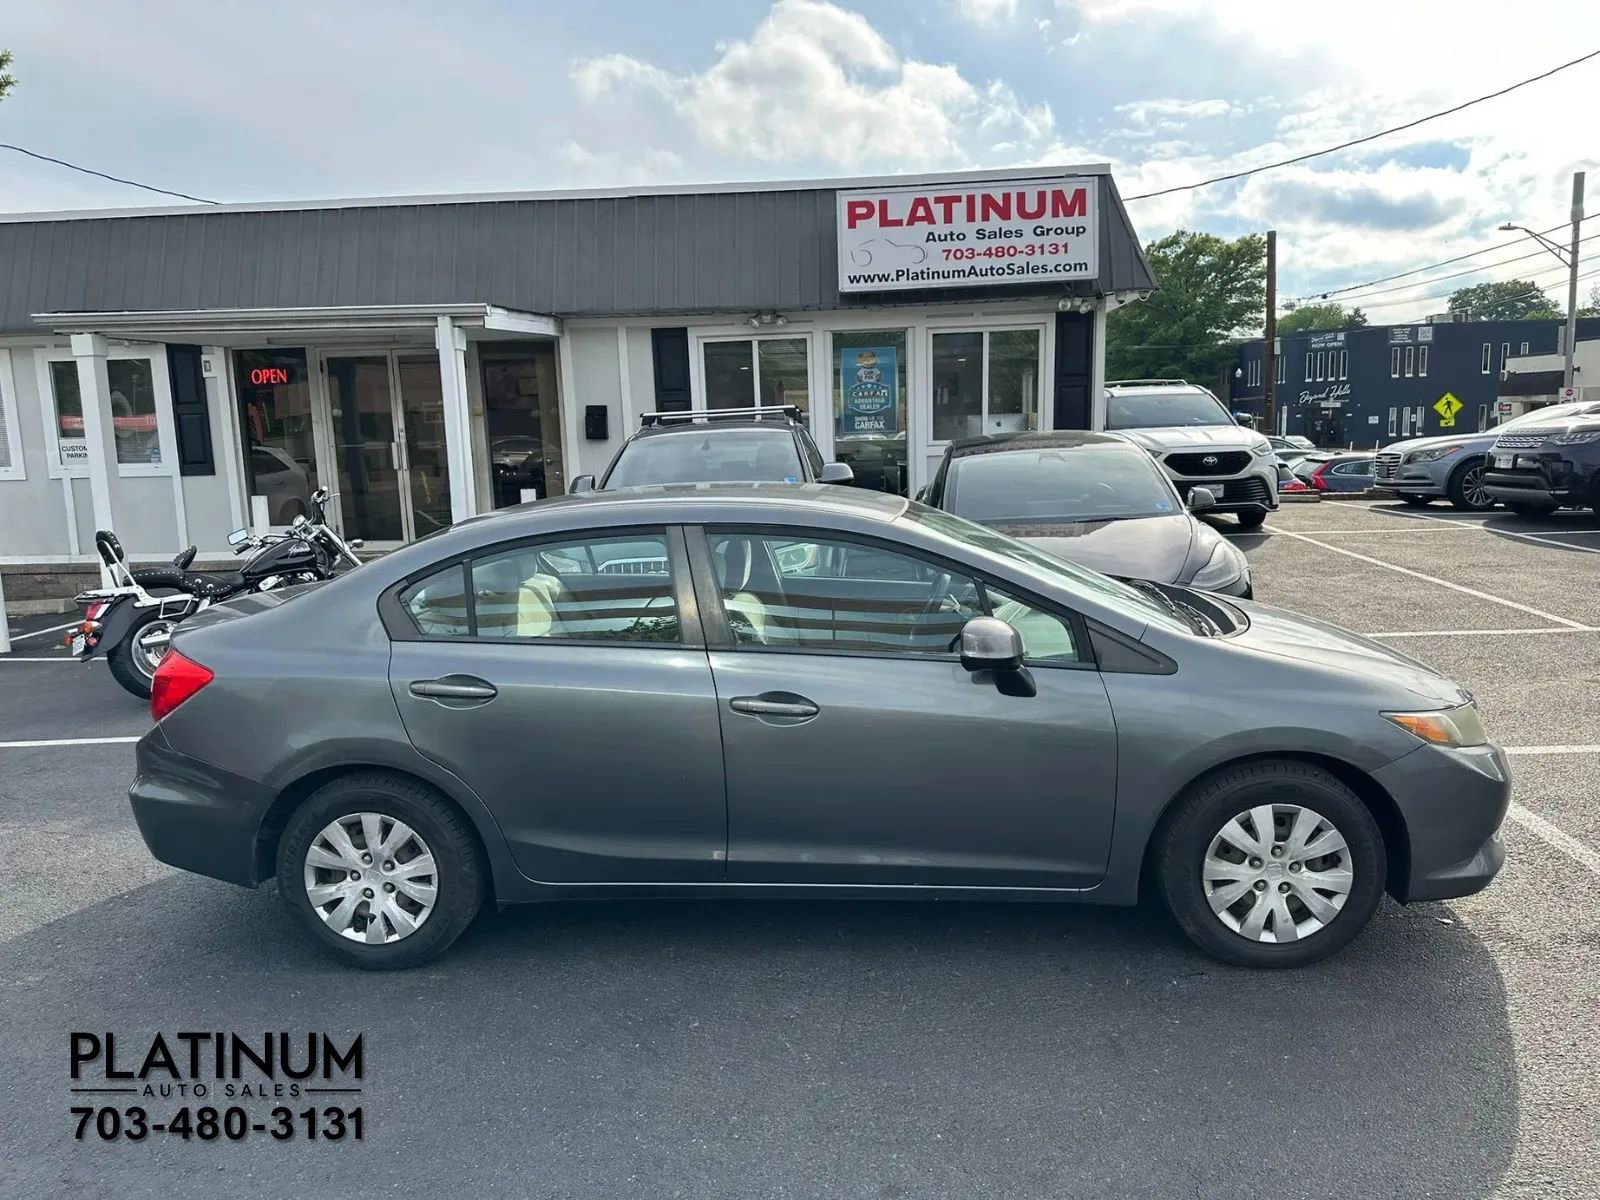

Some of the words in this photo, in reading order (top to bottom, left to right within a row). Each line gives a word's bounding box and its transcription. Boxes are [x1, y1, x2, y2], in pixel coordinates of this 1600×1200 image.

[847, 188, 1087, 229] PLATINUM
[925, 230, 966, 243] Auto
[975, 226, 1024, 240] Sales
[1032, 224, 1087, 238] Group
[941, 242, 1070, 261] 703-480-3131
[847, 261, 1088, 285] www.PlatinumAutoSales.com
[251, 368, 287, 384] OPEN
[854, 421, 885, 429] CARFAX
